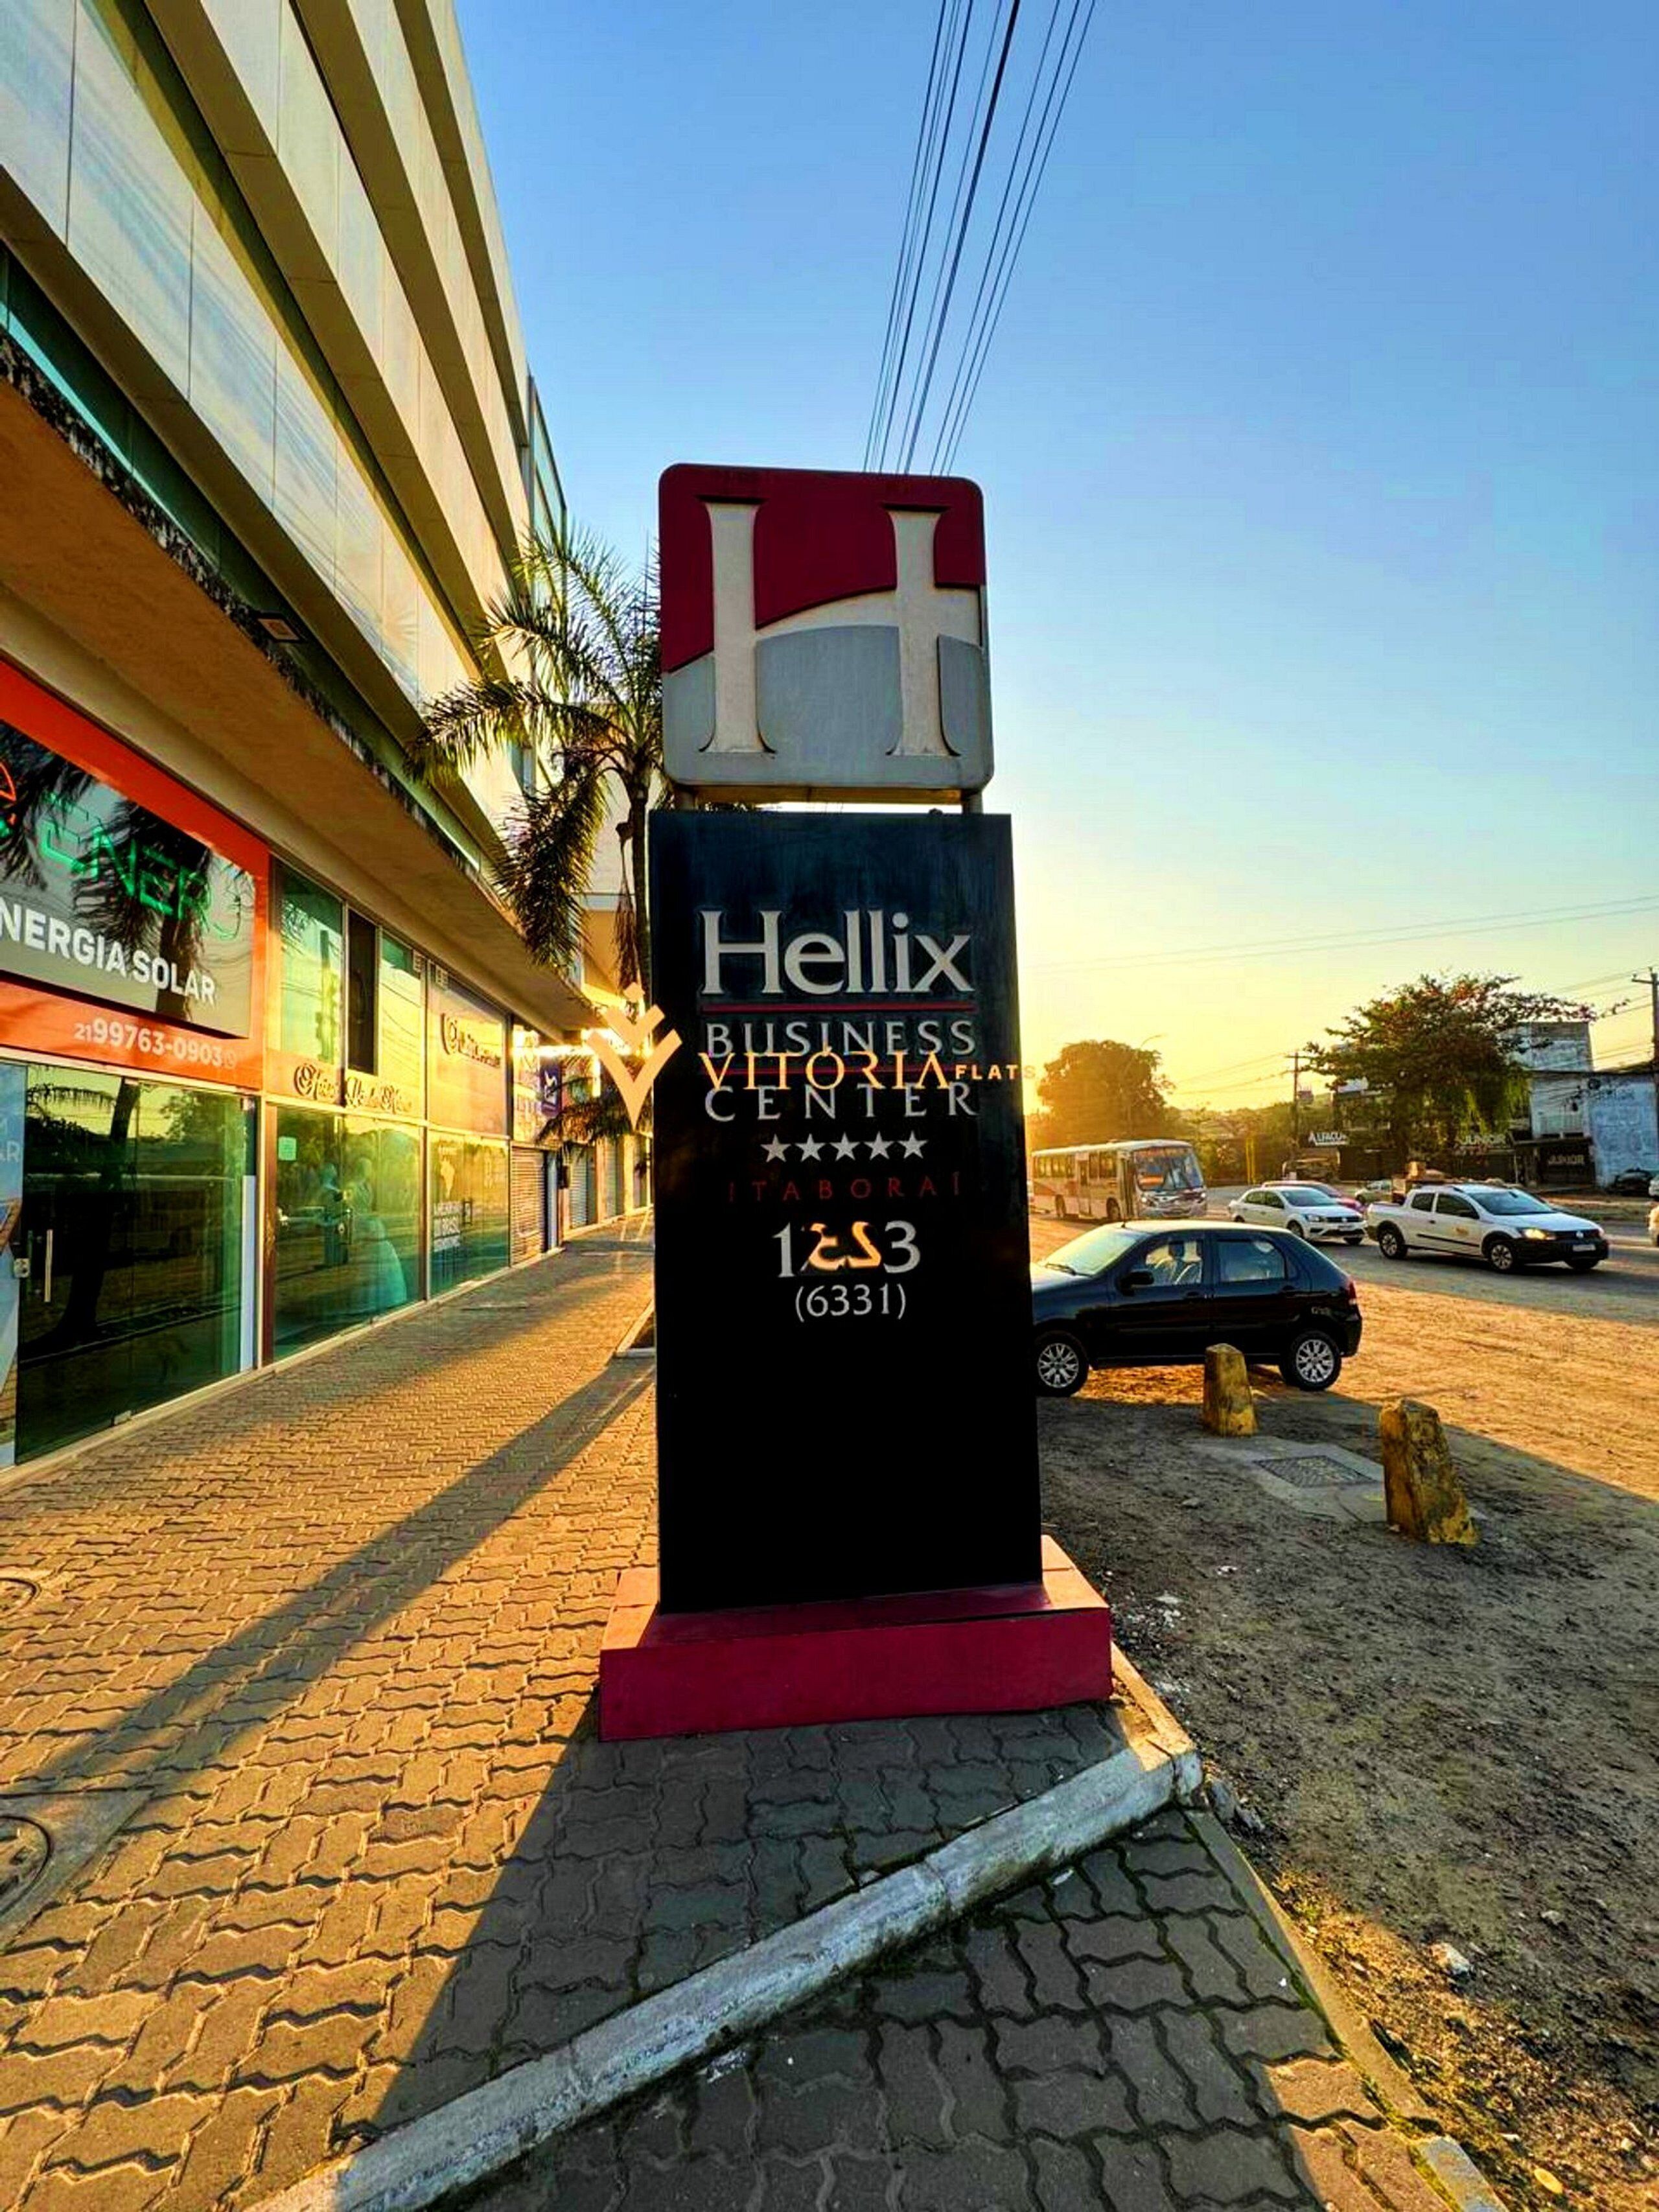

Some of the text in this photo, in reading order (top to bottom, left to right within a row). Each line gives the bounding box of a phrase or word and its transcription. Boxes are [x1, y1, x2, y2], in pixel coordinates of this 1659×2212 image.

[699, 909, 975, 995] Hellix
[132, 949, 216, 1005] SOLAR
[706, 1020, 976, 1058] BUSINESS
[704, 1082, 979, 1122] CENTER
[795, 1282, 907, 1323] (6331)
